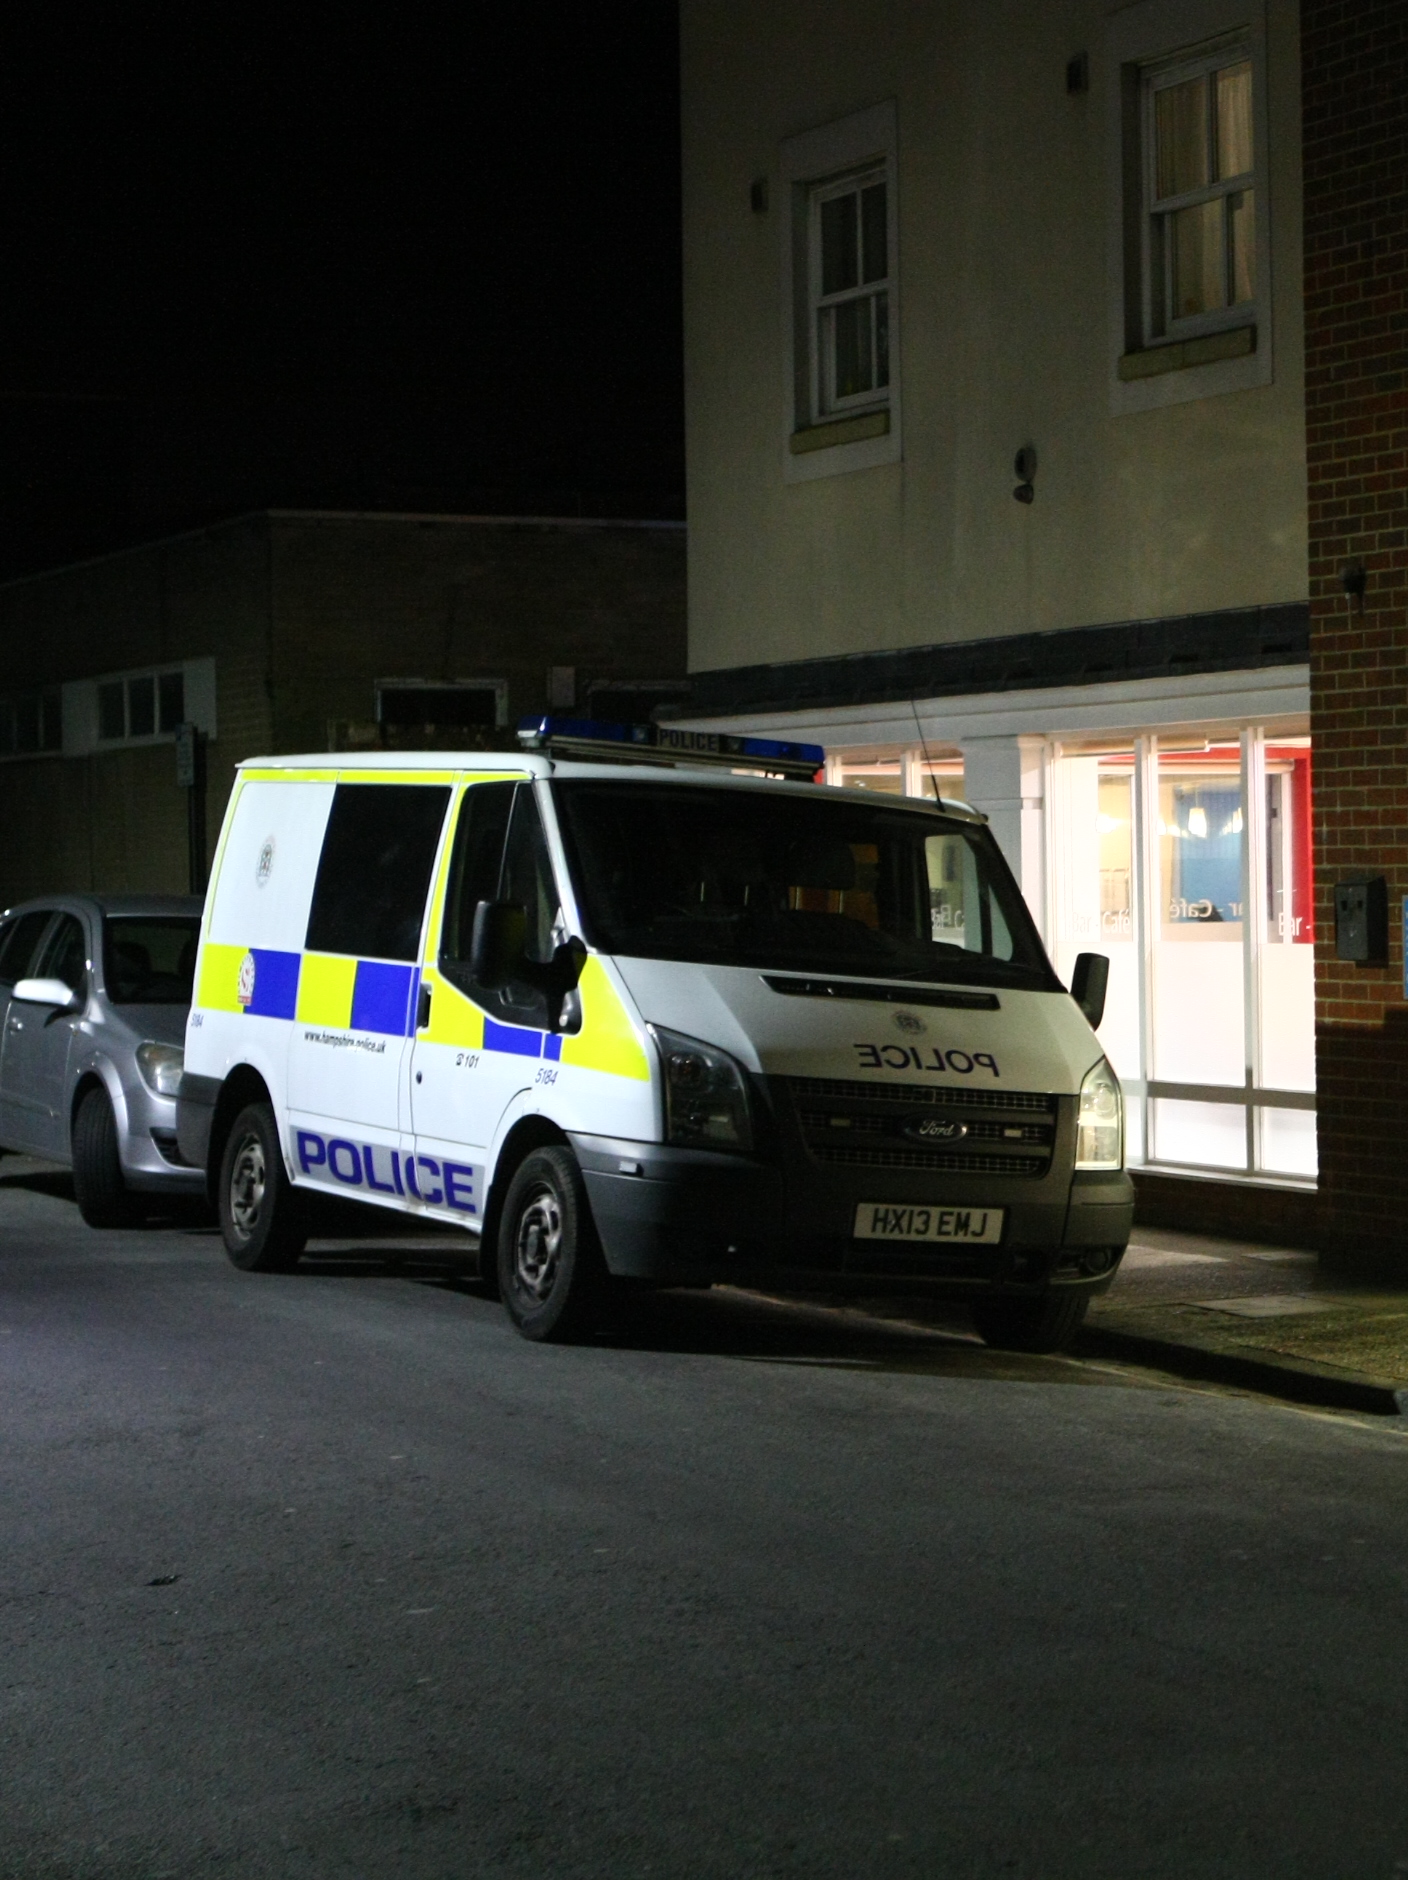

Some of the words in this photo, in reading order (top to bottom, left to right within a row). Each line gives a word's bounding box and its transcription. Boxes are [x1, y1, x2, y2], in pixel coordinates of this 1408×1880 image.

[659, 728, 718, 752] POLICE
[1102, 909, 1131, 934] Café
[464, 1055, 480, 1069] 101
[535, 1068, 559, 1086] 5184
[919, 1119, 955, 1138] Ford
[297, 1131, 477, 1214] POLICE
[871, 1208, 930, 1236] HX13
[937, 1211, 987, 1237] EMJ
